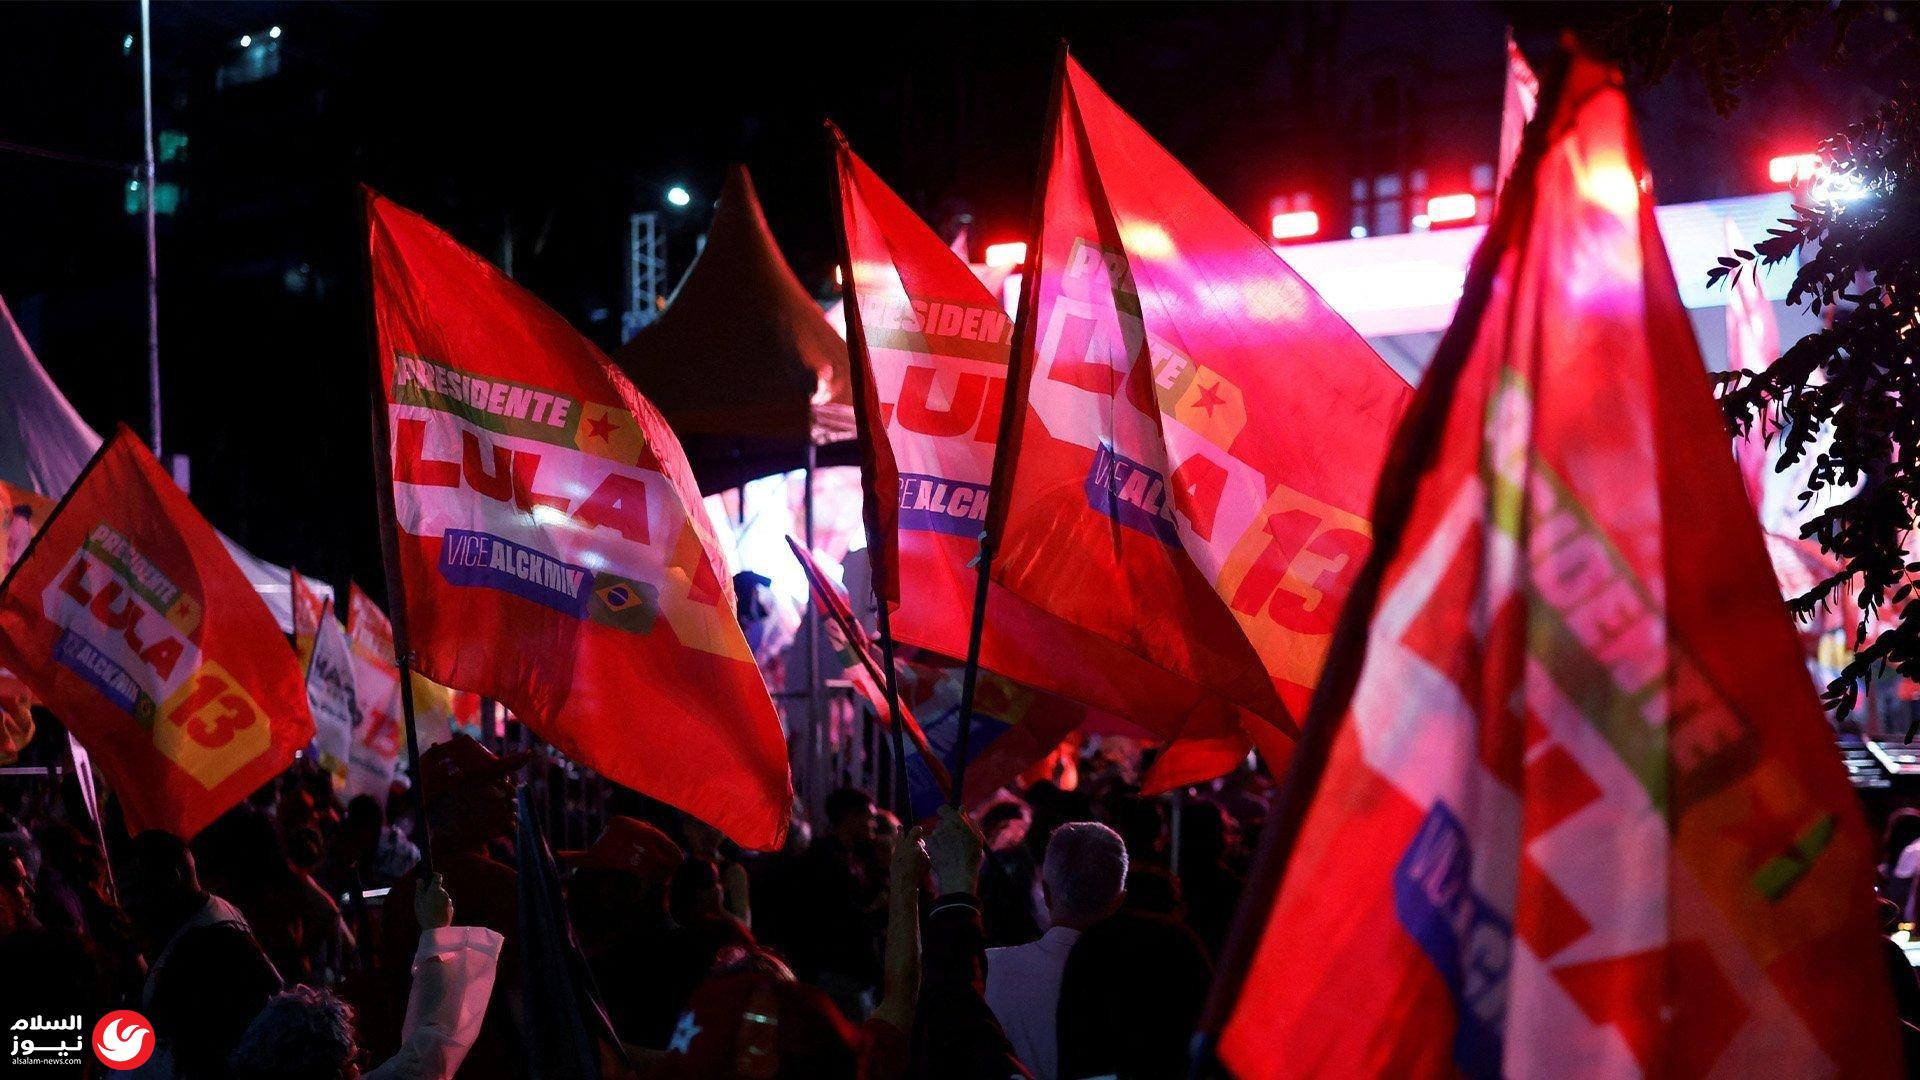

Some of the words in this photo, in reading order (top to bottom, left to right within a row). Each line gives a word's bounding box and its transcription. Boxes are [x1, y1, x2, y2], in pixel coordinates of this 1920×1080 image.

[397, 356, 571, 427] PRESIDENTE
[394, 420, 650, 545] LULA
[914, 481, 989, 520] ALCK
[59, 557, 184, 682] LULA
[1230, 509, 1373, 635] 13
[168, 676, 256, 747] 13
